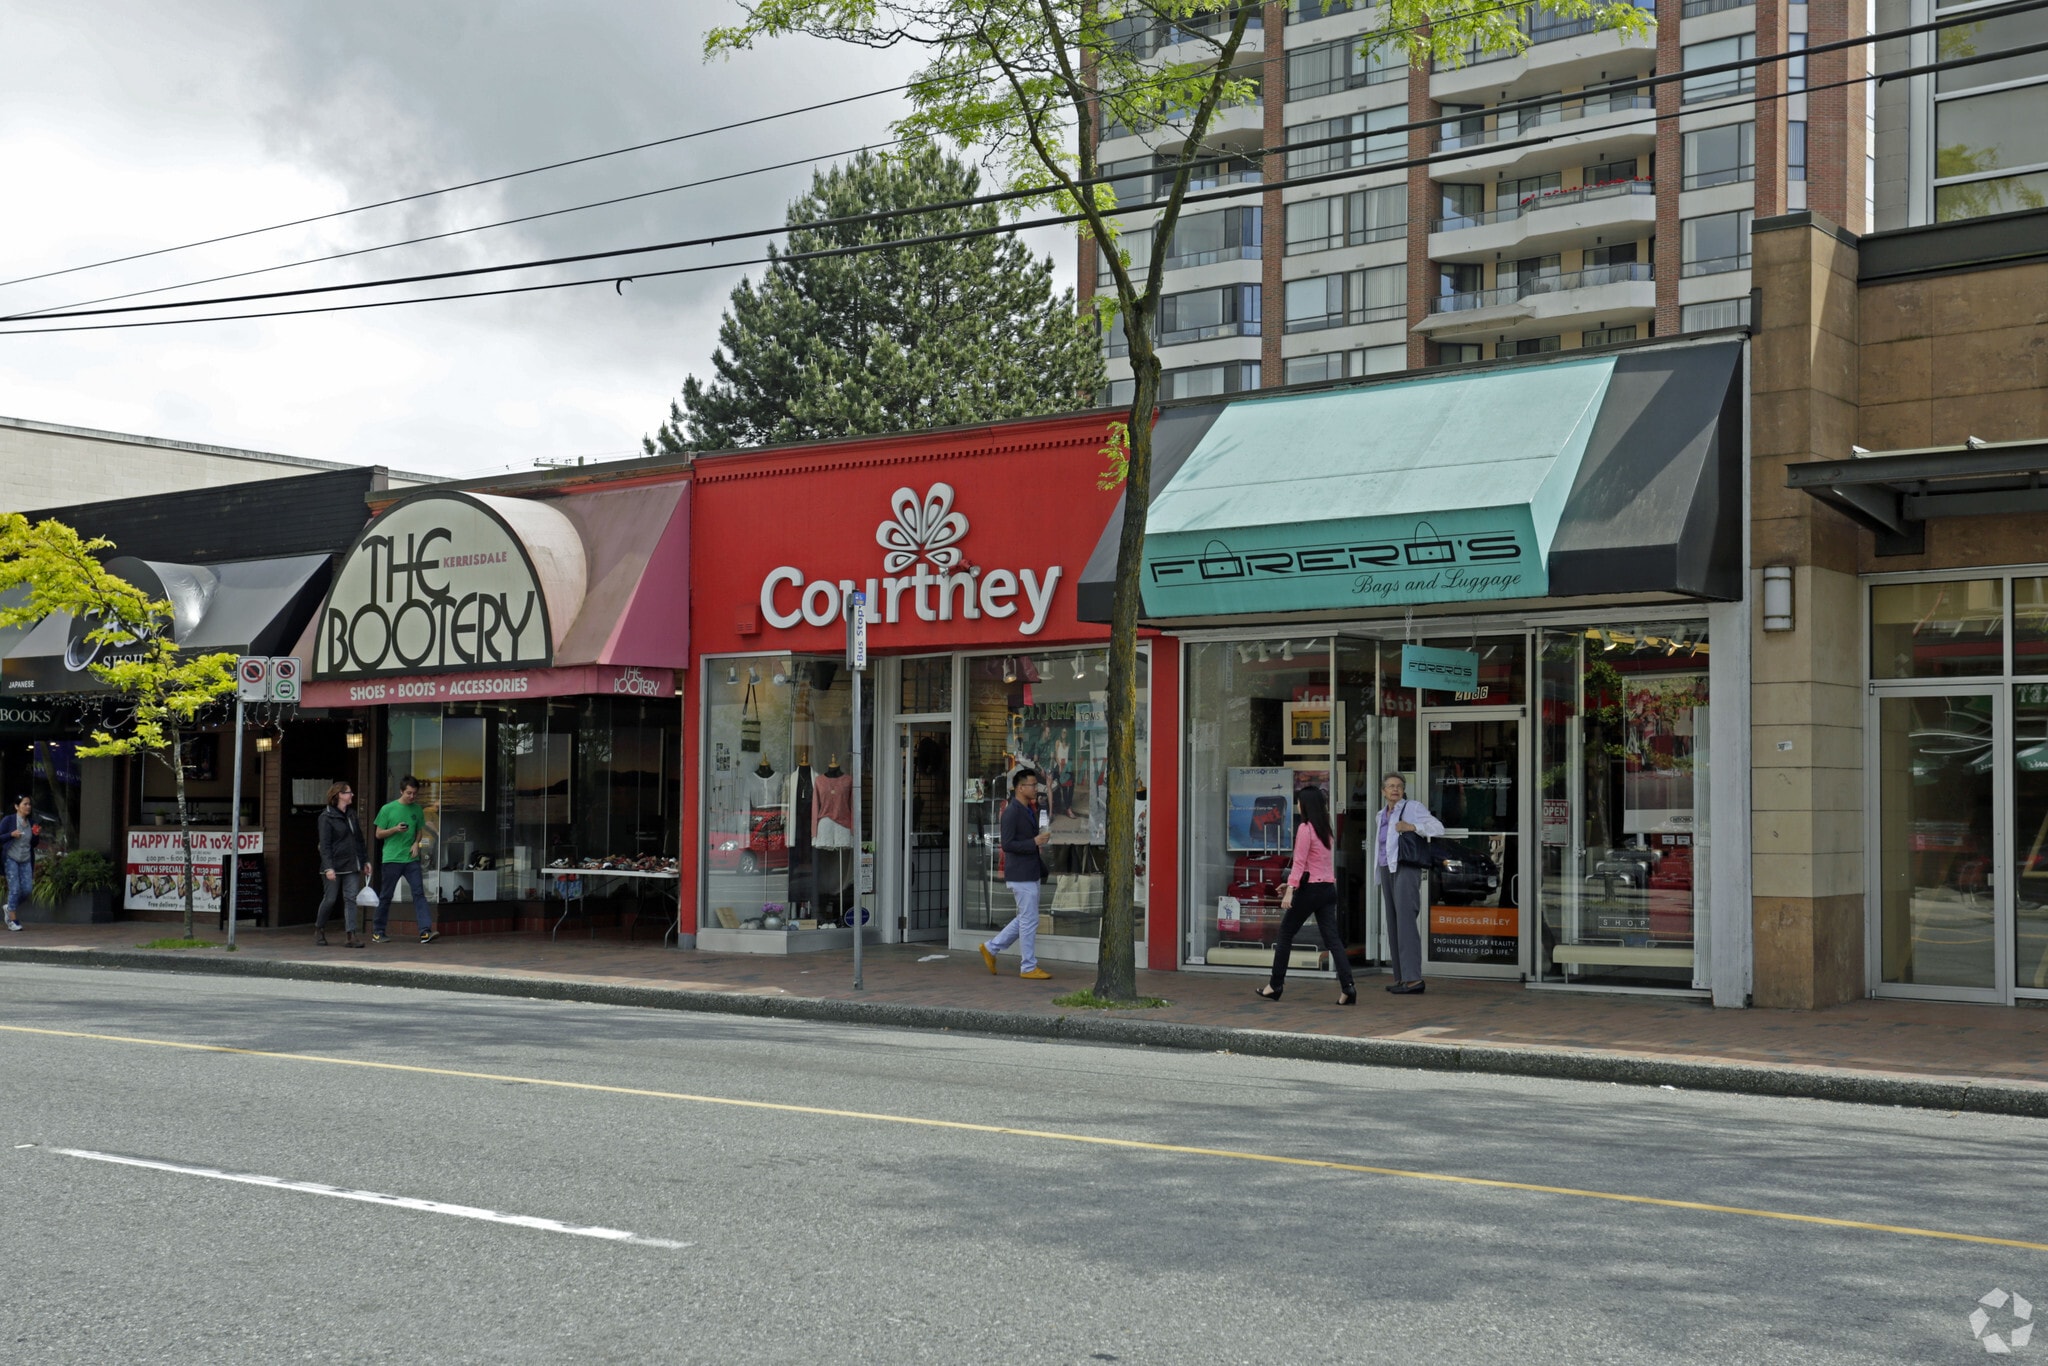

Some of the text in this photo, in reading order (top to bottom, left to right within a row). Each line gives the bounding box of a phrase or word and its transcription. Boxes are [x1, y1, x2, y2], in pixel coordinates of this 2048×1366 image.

[361, 527, 452, 605] THE
[443, 551, 507, 568] KERRISDALE
[1150, 536, 1521, 582] FORERO'S
[1352, 569, 1521, 599] Bags and Luggage
[760, 563, 1062, 635] Courtney
[328, 591, 535, 672] BOOTERY
[8, 680, 35, 689] JAPANESE
[350, 677, 528, 701] SHOES BOOTS ACCESSORIES
[614, 678, 660, 696] BOOTERY
[0, 709, 51, 723] BOOKS
[1080, 712, 1100, 721] TOMS
[1543, 806, 1566, 817] OPEN
[131, 834, 169, 849] HAPPY
[210, 834, 232, 850] 10%
[237, 835, 260, 849] OFF
[138, 865, 158, 873] LUNCH
[159, 865, 181, 873] SPECIAL
[1439, 916, 1511, 926] BRIGGS&RILEY
